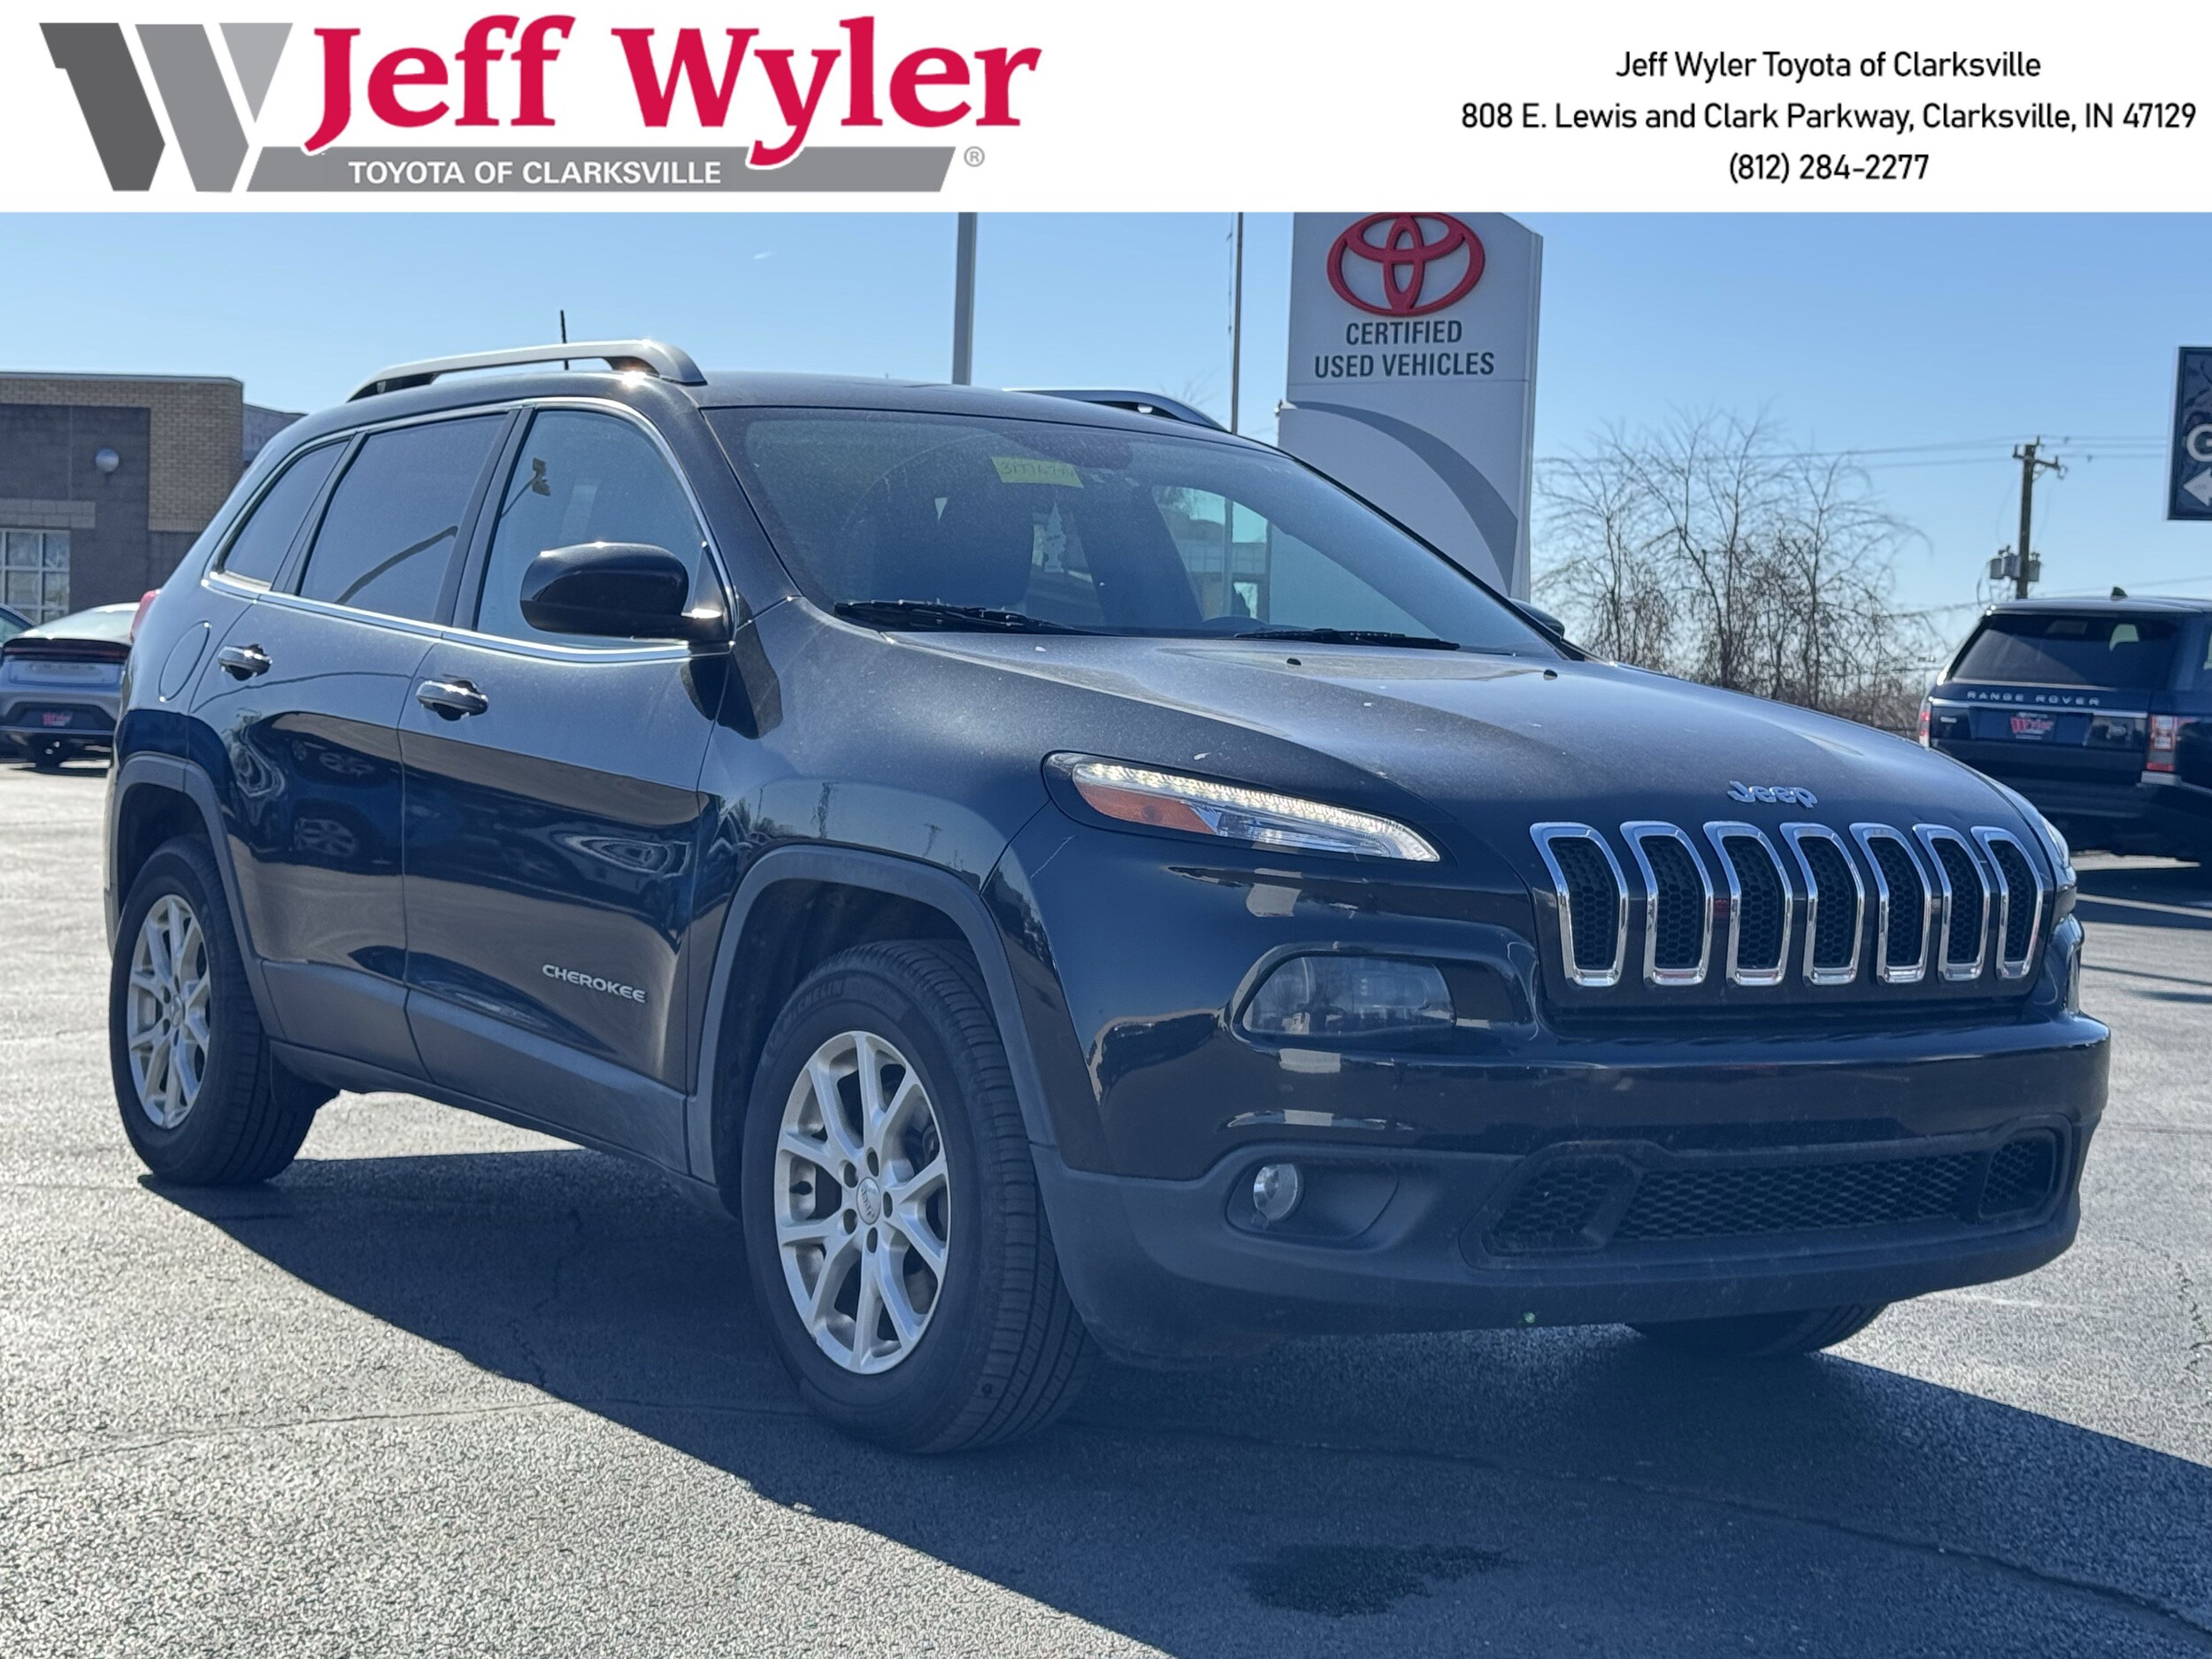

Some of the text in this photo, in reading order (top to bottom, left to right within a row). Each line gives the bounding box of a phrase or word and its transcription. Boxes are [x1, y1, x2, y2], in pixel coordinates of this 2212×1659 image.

[1346, 320, 1462, 345] CERTIFIED
[1315, 352, 1494, 378] USED VEHICLES
[1967, 690, 2100, 706] RANGE ROVER
[1726, 780, 1818, 808] Jeep
[541, 964, 646, 1003] CHEROKEE
